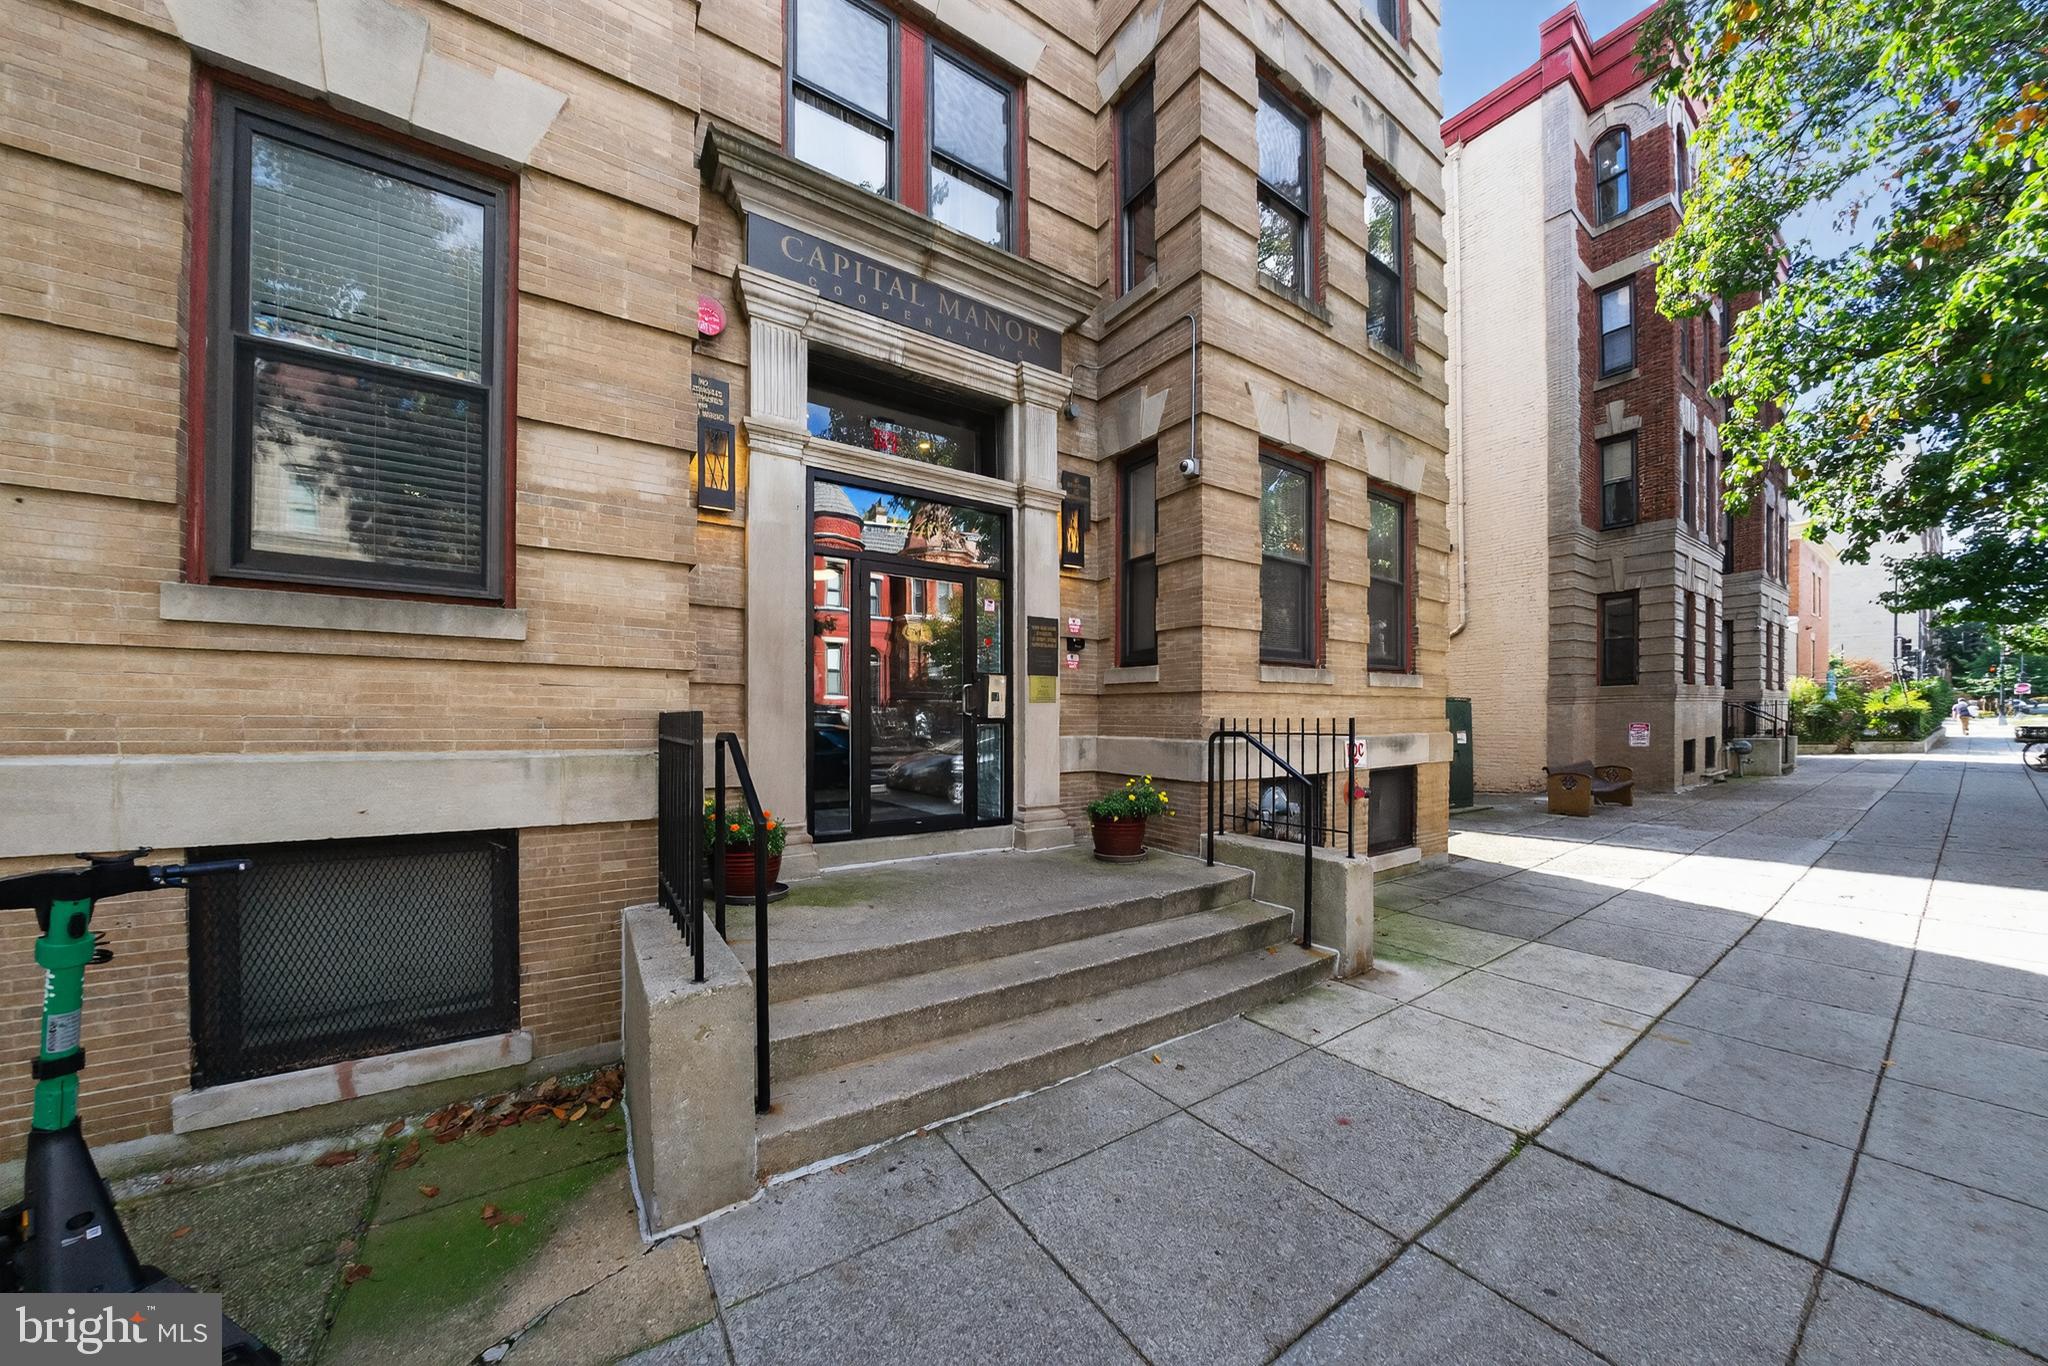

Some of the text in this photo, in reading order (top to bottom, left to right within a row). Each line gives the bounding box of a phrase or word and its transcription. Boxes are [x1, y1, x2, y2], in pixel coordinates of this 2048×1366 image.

[781, 235, 1041, 350] CAPITAL MANOR
[808, 276, 1024, 360] COOPERATIVE
